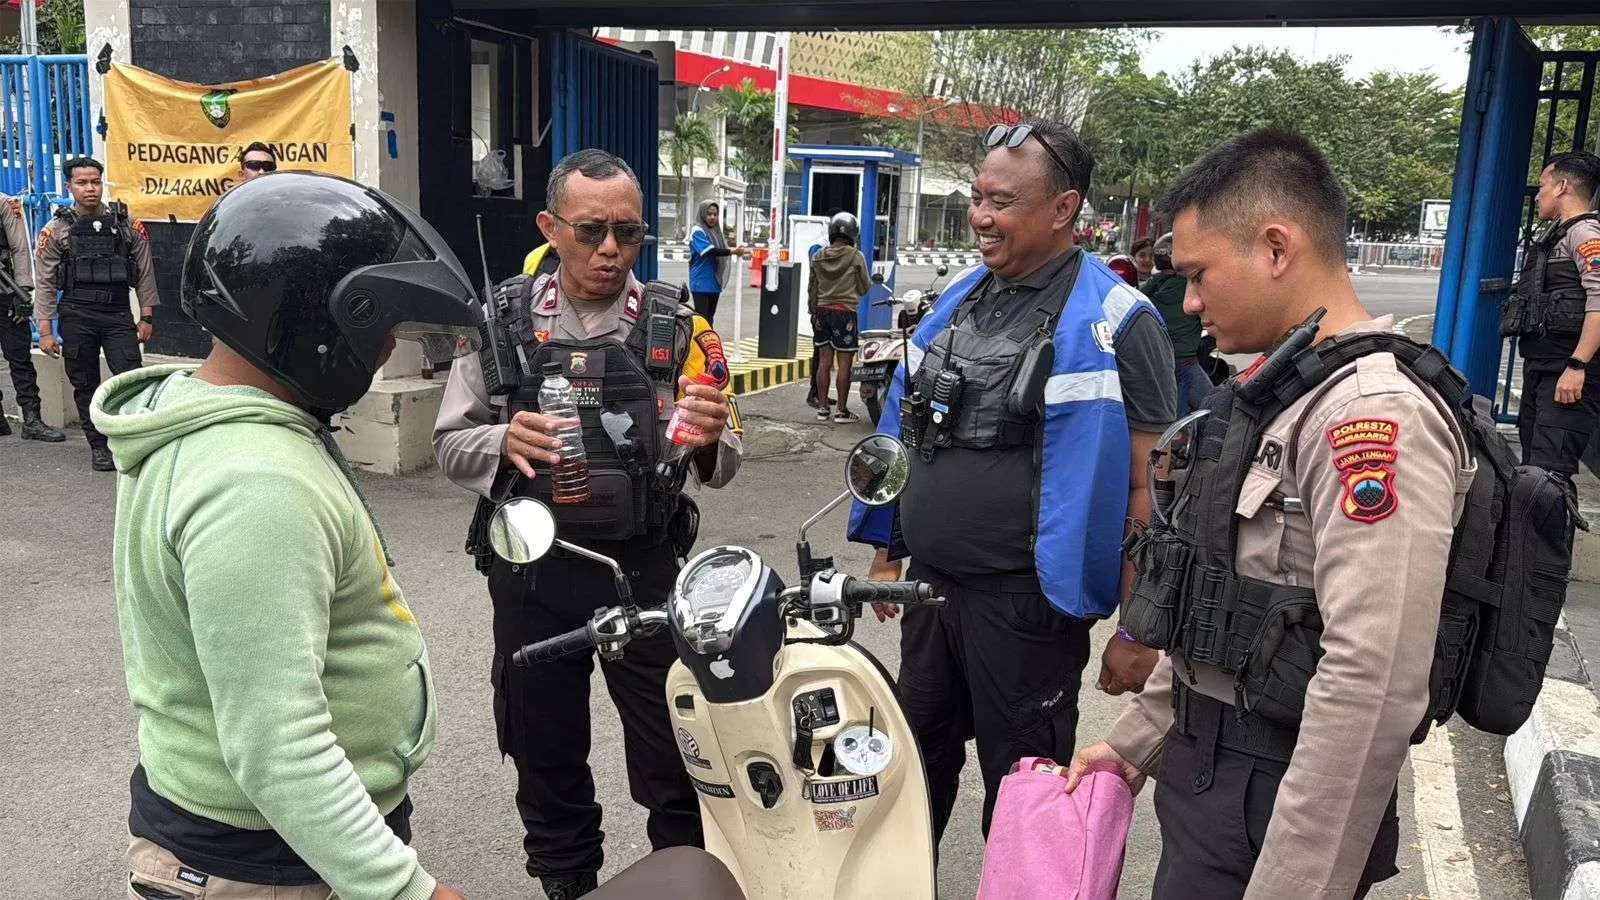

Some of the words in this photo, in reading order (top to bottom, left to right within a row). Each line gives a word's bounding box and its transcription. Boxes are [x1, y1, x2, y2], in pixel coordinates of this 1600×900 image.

[127, 142, 229, 165] PEDAGANG
[231, 142, 328, 163] ANGAN
[145, 177, 234, 196] DILARANG
[1332, 421, 1393, 438] POLRESTA
[1340, 454, 1360, 466] JAWA
[1361, 450, 1392, 460] TENGAH
[812, 783, 837, 797] LOVE
[838, 781, 850, 796] OF
[852, 777, 875, 794] LIFE
